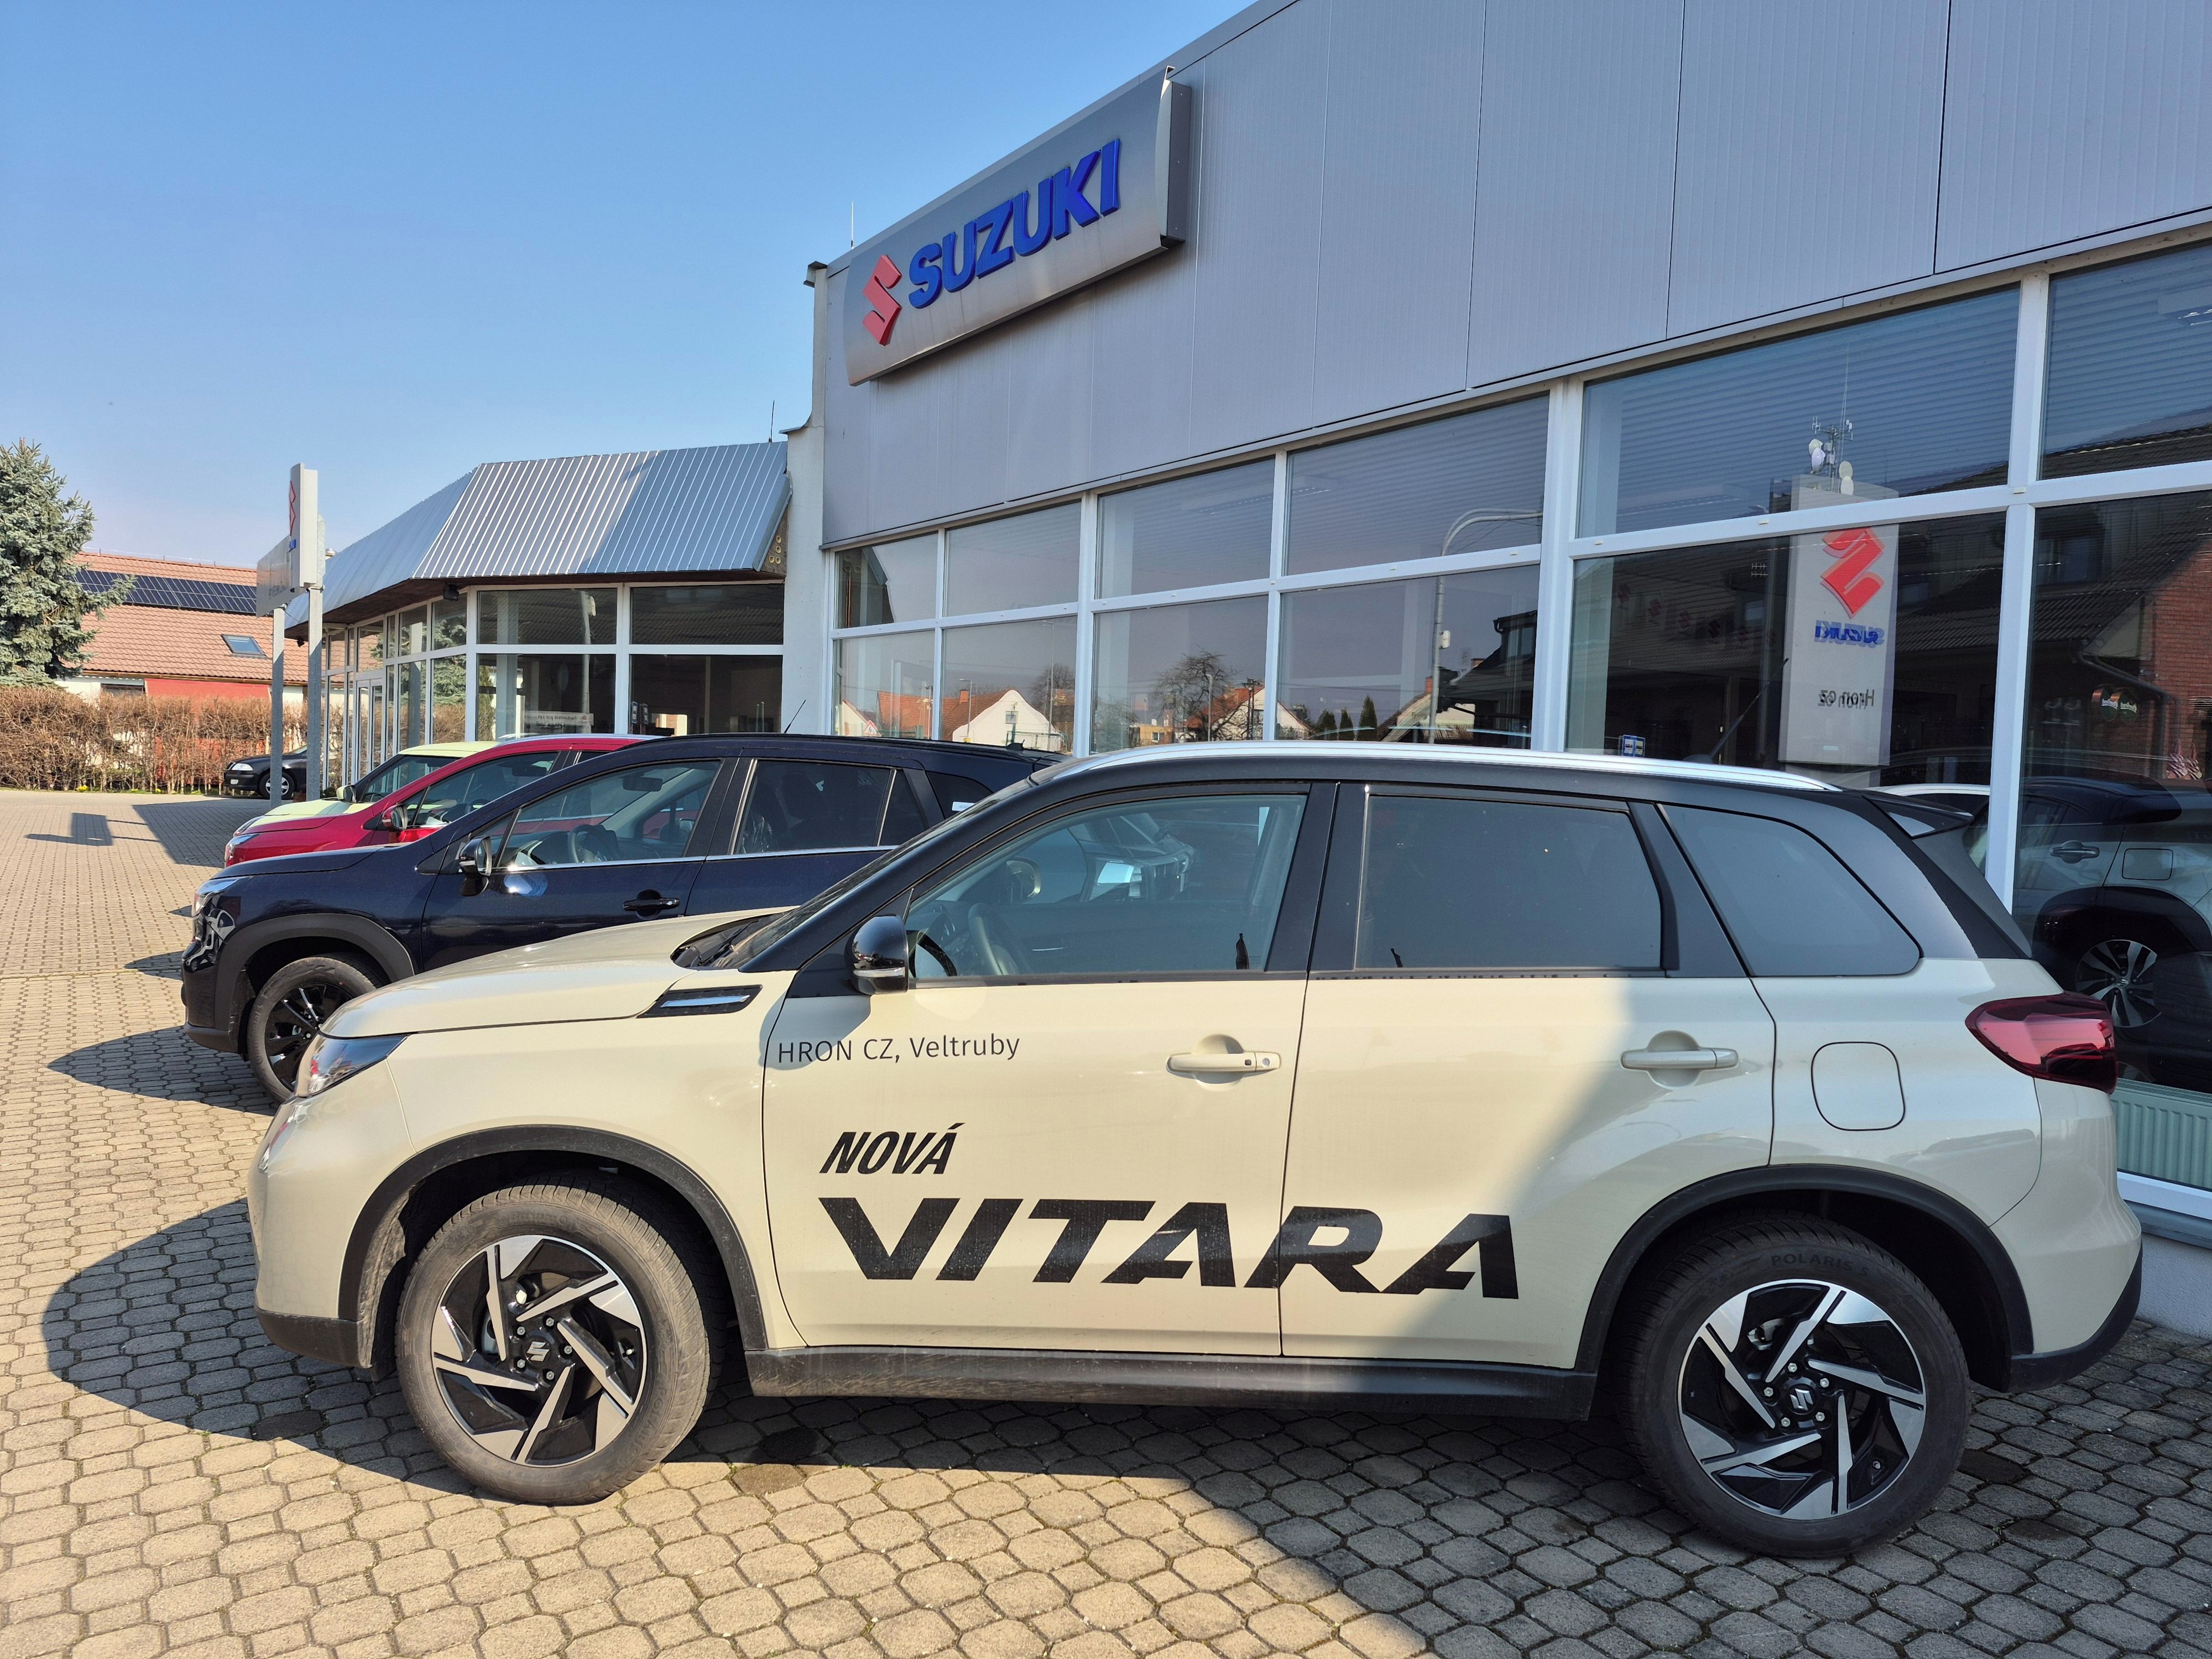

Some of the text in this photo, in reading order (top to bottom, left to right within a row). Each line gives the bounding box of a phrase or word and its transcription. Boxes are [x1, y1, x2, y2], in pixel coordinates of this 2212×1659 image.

[909, 138, 1121, 309] SUZUKI
[778, 1033, 1020, 1063] HRON CZ, Veltruby
[819, 1123, 966, 1175] NOVÁ
[818, 1197, 1519, 1300] VITARA
[1771, 1253, 1853, 1271] POLARIS
